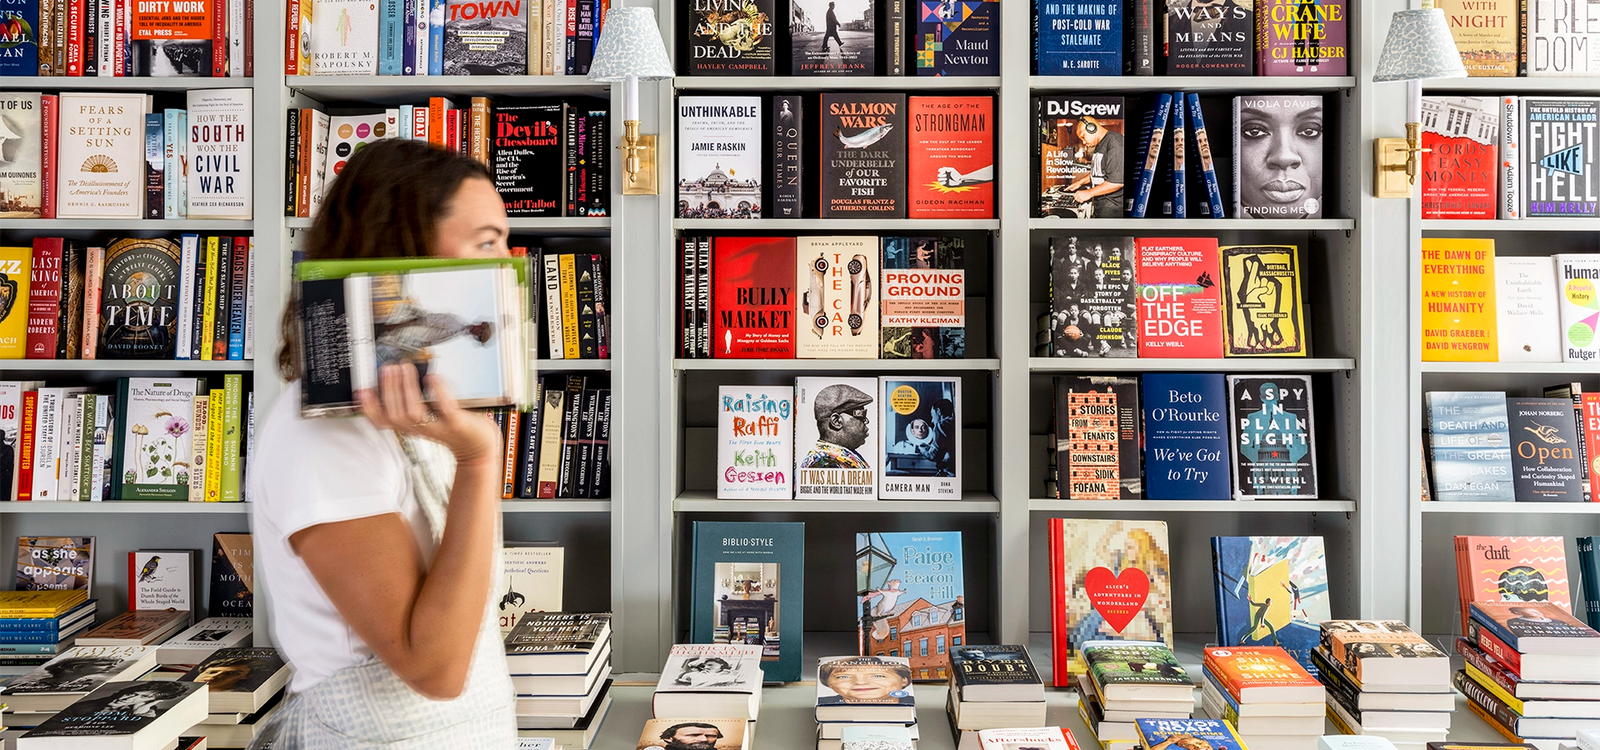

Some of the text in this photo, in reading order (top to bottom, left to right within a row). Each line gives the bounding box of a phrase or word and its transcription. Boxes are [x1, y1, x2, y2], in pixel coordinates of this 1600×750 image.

[139, 1, 205, 13] DIRTY WORK
[450, 1, 520, 20] TOWN
[1174, 7, 1247, 20] WAYS
[1271, 5, 1343, 22] CRANE
[1052, 21, 1110, 31] POST-COLD WAR
[1451, 16, 1508, 28] NIGHT
[1175, 32, 1246, 42] MEANS
[1274, 24, 1326, 40] WIFE
[956, 39, 988, 50] Maud
[1061, 36, 1101, 46] STALEMATE
[693, 46, 741, 60] DEAD
[944, 54, 988, 64] Newton
[1272, 47, 1345, 58] CJ HAUSER
[315, 60, 372, 69] SAPOLSKY
[79, 106, 124, 114] FEARS
[681, 106, 756, 118] UNTHINKABLE
[830, 103, 896, 116] SALMON
[1047, 101, 1120, 115] DJ Screw
[415, 110, 426, 137] HOAX
[496, 113, 518, 123] The
[840, 116, 887, 128] WARS
[916, 114, 985, 132] STRONGMAN
[1530, 113, 1596, 121] AMERICAN LABOR
[69, 127, 132, 135] SETTING
[192, 125, 244, 142] SOUTH
[496, 122, 557, 137] Devil's
[86, 139, 114, 147] SUN
[496, 137, 557, 147] Chessboard
[691, 142, 746, 151] JAMIE RASKIN
[1531, 122, 1596, 163] FIGHT
[786, 128, 798, 186] QUEEN
[1547, 146, 1580, 174] LIKE
[196, 156, 240, 172] CIVIL
[200, 176, 234, 193] WAR
[839, 178, 887, 187] FAVORITE
[1531, 164, 1597, 201] HELL
[852, 188, 874, 196] FISH
[1531, 203, 1596, 213] KIM KELLY
[32, 257, 60, 268] LAST
[31, 270, 58, 282] KING
[546, 260, 557, 290] LAND
[1424, 264, 1485, 275] EVERYTHING
[886, 274, 963, 284] PROVING
[107, 284, 176, 299] ABOUT
[231, 245, 244, 334] CHAOS UNDER HEAVEN
[832, 254, 843, 336] THE CAR
[887, 286, 961, 296] GROUND
[1143, 286, 1184, 302] OFF
[737, 288, 791, 306] BULLY
[1143, 303, 1186, 319] THE
[1428, 302, 1484, 313] HUMANITY
[107, 306, 173, 326] TIME
[720, 311, 791, 328] MARKET
[1145, 320, 1203, 336] EDGE
[1569, 348, 1596, 360] Rutger
[132, 388, 143, 396] The
[144, 388, 165, 396] Nature
[174, 388, 193, 398] Drugs
[1169, 389, 1202, 403] Beto
[722, 393, 791, 420] Raising
[1080, 406, 1115, 415] STORIES
[1152, 408, 1220, 422] O'Rourke
[733, 416, 779, 438] Raffi
[1241, 418, 1306, 430] PLAIN
[22, 396, 34, 469] SUPERPOWER INTERRUPTED
[1083, 432, 1115, 441] TENANTS
[1241, 433, 1307, 445] SIGHT
[734, 449, 776, 467] Keith
[1072, 454, 1116, 463] DOWNSTAIRS
[1153, 449, 1221, 462] We've Got
[1518, 441, 1574, 464] Open
[724, 467, 785, 484] Gessen
[800, 470, 872, 485] IT WAS ALL A DREAM
[1168, 467, 1208, 484] to Try
[885, 483, 930, 493] CAMERA MAN
[32, 548, 77, 559] as she
[903, 547, 954, 570] Paige
[1485, 545, 1511, 561] drift
[24, 565, 83, 578] appears
[905, 571, 954, 583] Beacon
[930, 586, 954, 599] Hill
[1480, 635, 1503, 659] REBEL YELL
[964, 663, 1028, 673] DOUBT
